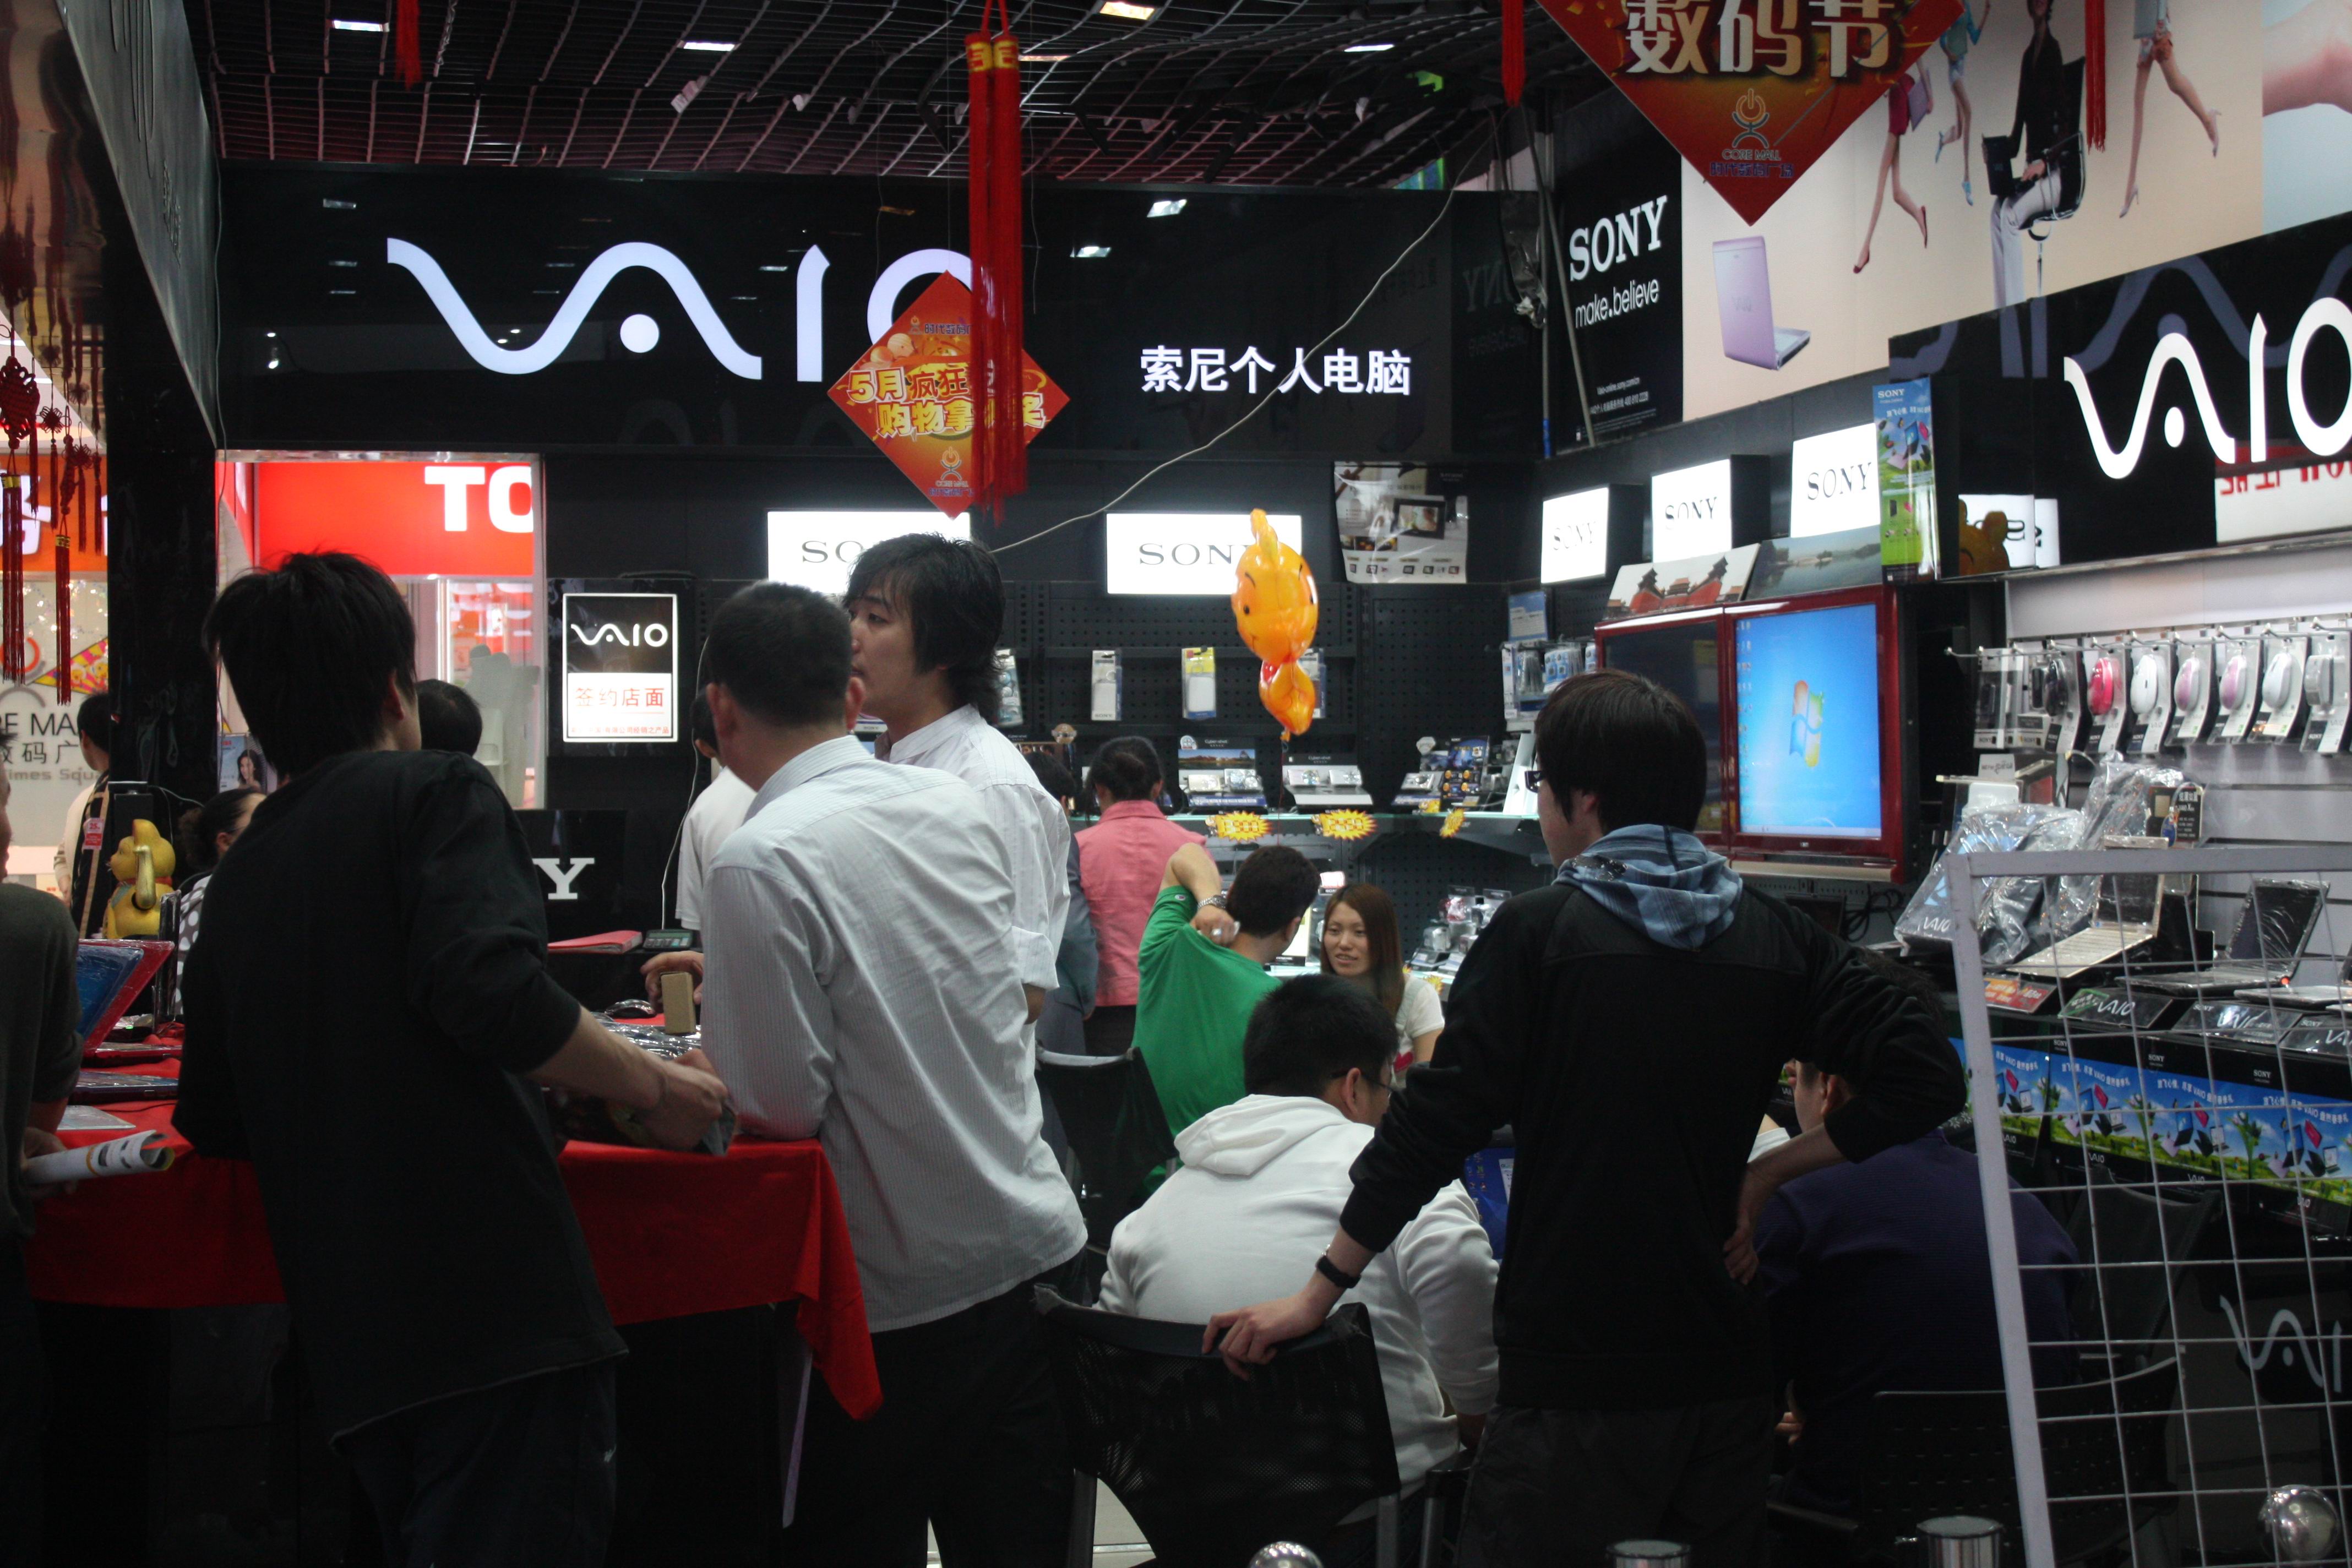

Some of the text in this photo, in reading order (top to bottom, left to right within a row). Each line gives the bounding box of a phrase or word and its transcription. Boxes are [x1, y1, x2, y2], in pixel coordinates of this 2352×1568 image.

[1626, 0, 1894, 78] 数码节
[1722, 149, 1781, 161] CORE MALL
[1710, 162, 1794, 178] 时代数码广场
[1569, 195, 1668, 282] SONY
[1575, 279, 1660, 329] make.believe
[924, 323, 971, 335] 时代数码
[1140, 345, 1412, 395] 索尼个人电脑
[848, 366, 995, 403] 5月疯狂
[1878, 389, 1904, 398] SONY
[2064, 297, 2352, 479] VAIO
[1807, 462, 1872, 500] SONY
[1664, 496, 1717, 530] SONY
[1553, 520, 1596, 551] SONY
[802, 541, 865, 563] SO
[1138, 543, 1248, 566] SON
[571, 623, 668, 648] VAIO
[575, 687, 665, 707] 签约店面
[31, 713, 79, 736] MA
[9, 769, 52, 780] imes
[2097, 999, 2136, 1016] VAIO
[2148, 1054, 2164, 1063] SONY
[2253, 1069, 2271, 1079] SONY
